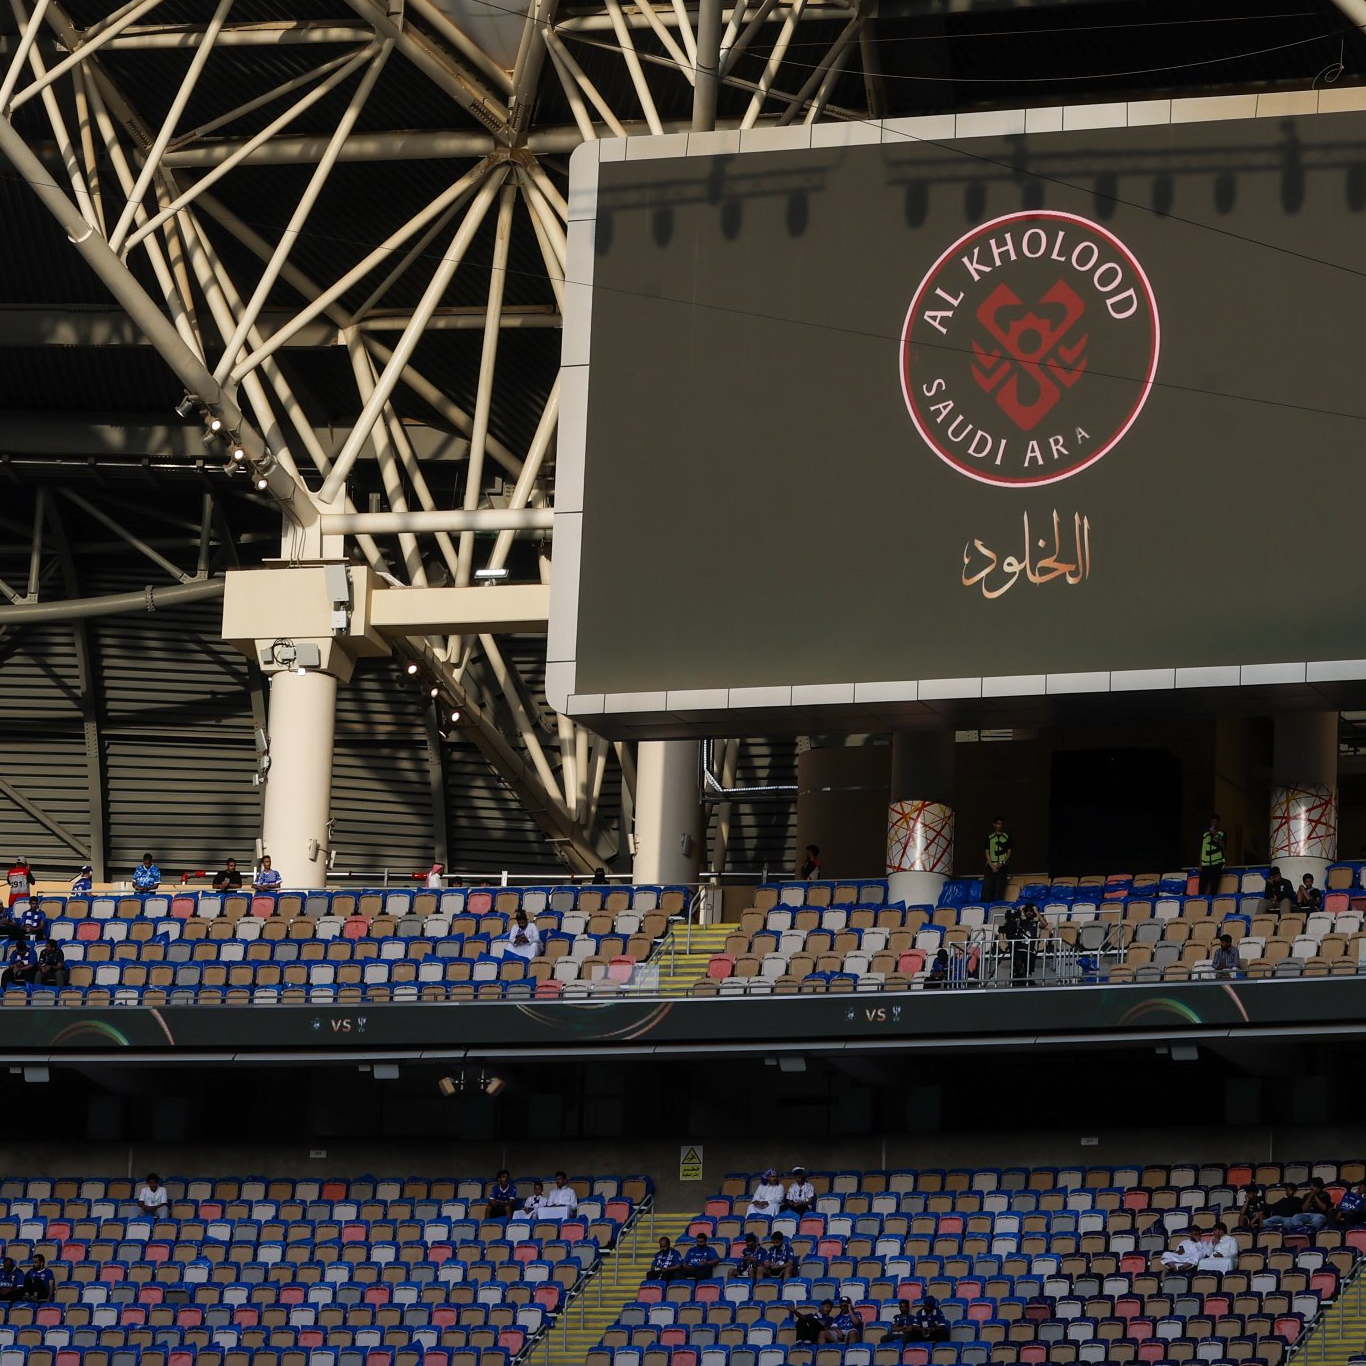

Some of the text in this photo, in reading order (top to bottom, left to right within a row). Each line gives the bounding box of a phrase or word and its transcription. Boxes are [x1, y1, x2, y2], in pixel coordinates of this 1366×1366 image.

[923, 228, 1139, 335] AL KHOLOOD
[922, 377, 1007, 466] SAUDI
[961, 508, 1092, 600] الخلود
[331, 1019, 351, 1032] VS
[865, 1008, 886, 1021] VS
